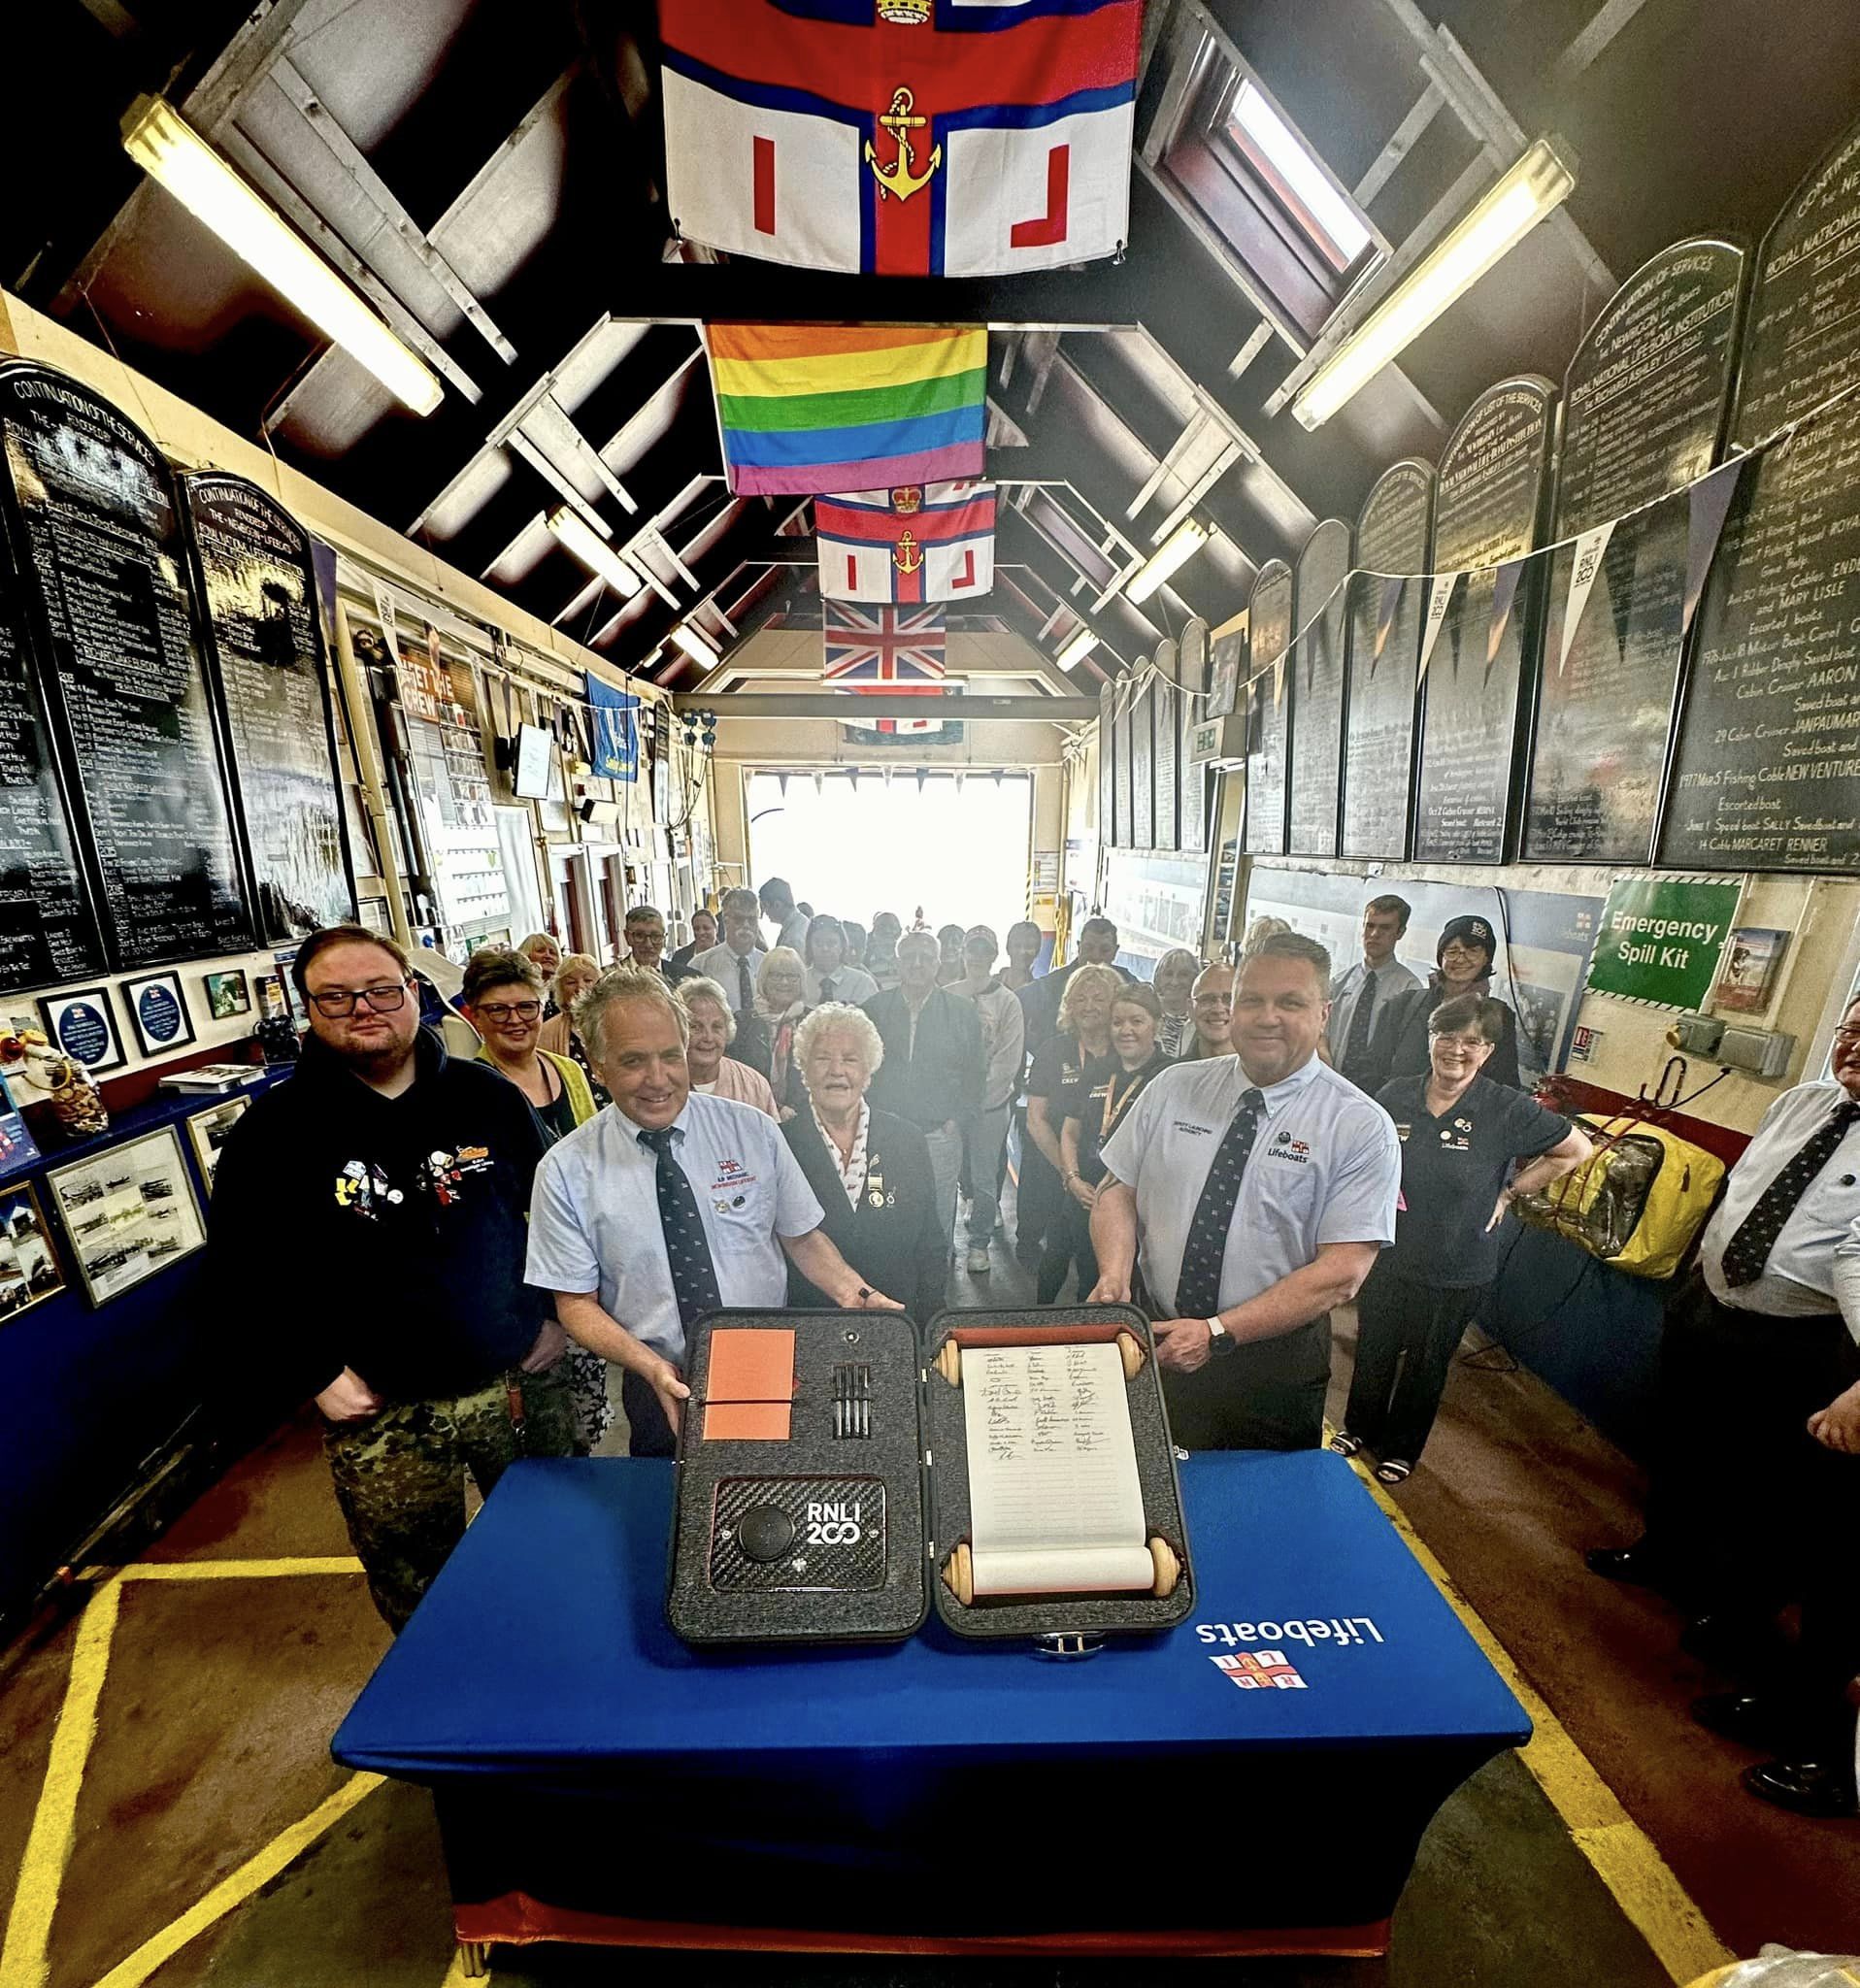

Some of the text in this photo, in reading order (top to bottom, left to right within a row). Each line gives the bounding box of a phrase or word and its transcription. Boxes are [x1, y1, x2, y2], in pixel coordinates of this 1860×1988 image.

[1594, 255, 1714, 348] CONTINUATION OF SERVICES
[1516, 391, 1544, 414] SERVICES
[1813, 580, 1846, 602] LISLE
[1748, 614, 1788, 635] Escorted
[1807, 663, 1858, 689] AARON
[1782, 741, 1814, 757] Saved
[1838, 734, 1857, 751] and
[1723, 768, 1757, 791] Fishing
[1785, 763, 1810, 781] NEW
[1810, 758, 1860, 779] VENTURE
[1718, 796, 1781, 812] Escorted boat
[1731, 837, 1783, 852] MARGARET
[1786, 837, 1828, 852] RENNER
[1611, 911, 1718, 945] Emergency
[1617, 941, 1689, 970] Spill Kit
[1268, 1147, 1309, 1164] Lifeboats
[807, 1503, 861, 1522] RNLI
[807, 1521, 861, 1544] 200
[1196, 1617, 1384, 1646] Lifeboats
